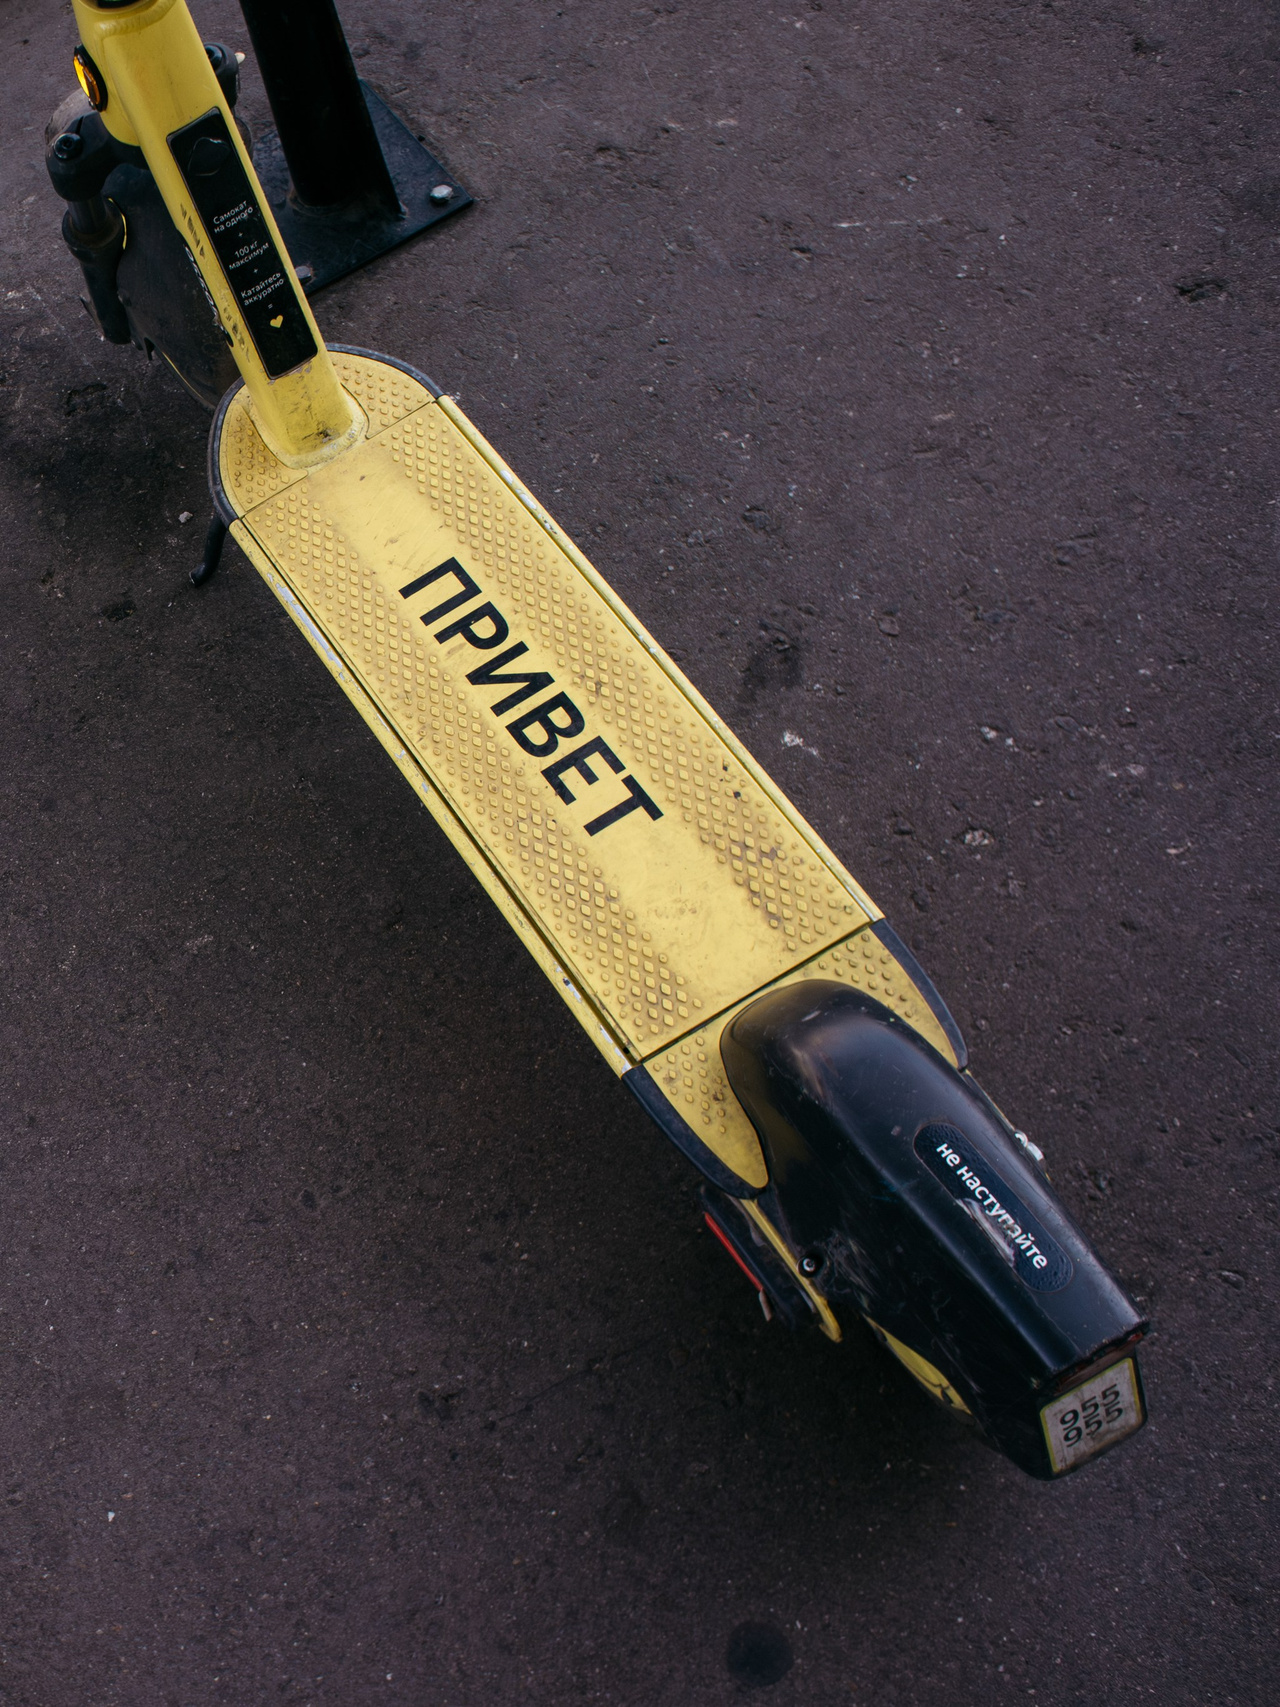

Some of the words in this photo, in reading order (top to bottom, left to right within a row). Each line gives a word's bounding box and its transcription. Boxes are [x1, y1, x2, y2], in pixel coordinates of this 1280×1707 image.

[213, 200, 247, 224] Самокат
[214, 225, 225, 234] на
[225, 206, 254, 228] одного
[229, 242, 270, 270] максимум
[234, 245, 250, 258] 100
[249, 241, 258, 250] кг
[240, 272, 281, 298] Катайтесь
[244, 278, 285, 306] аккуратно
[398, 556, 665, 837] ПРИВЕТ
[936, 1143, 961, 1167] не
[956, 1166, 1048, 1269] наступайте
[1059, 1383, 1120, 1431] 955
[1063, 1400, 1124, 1448] 955
